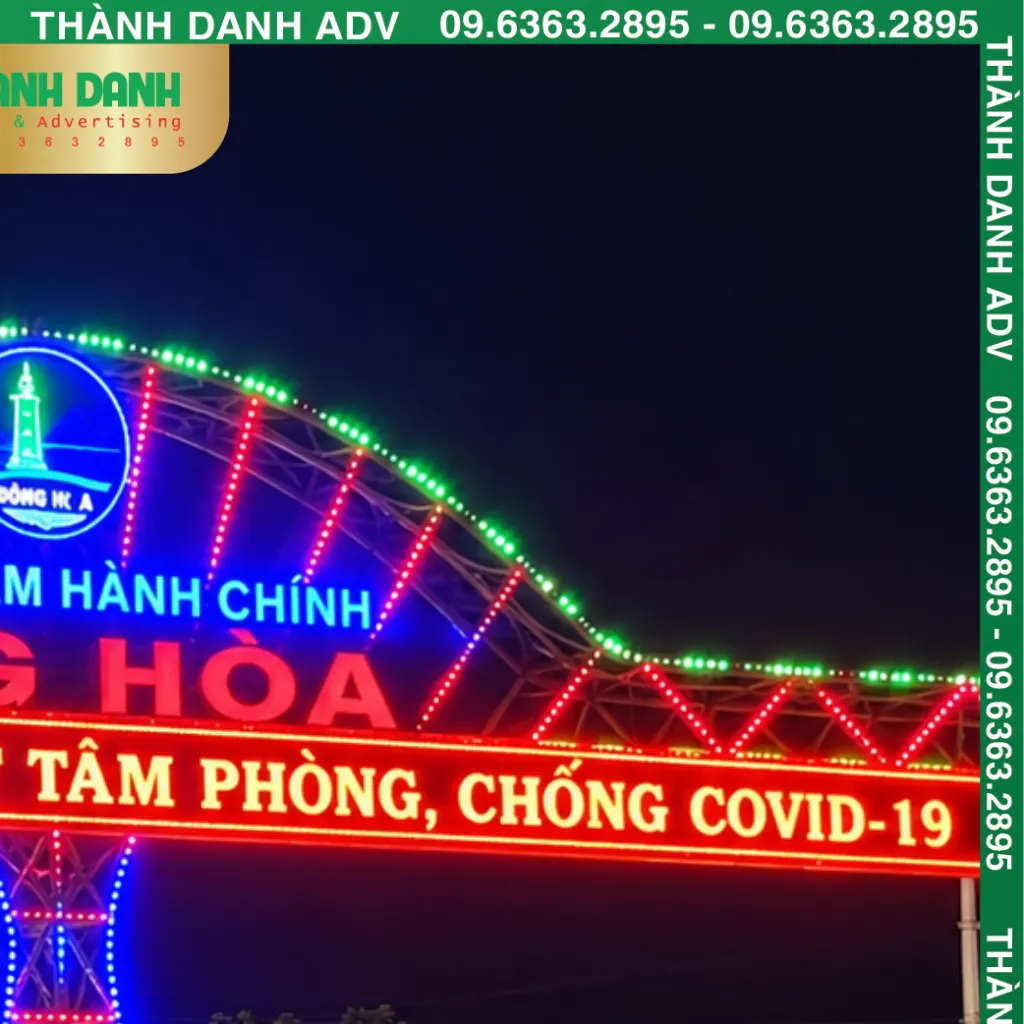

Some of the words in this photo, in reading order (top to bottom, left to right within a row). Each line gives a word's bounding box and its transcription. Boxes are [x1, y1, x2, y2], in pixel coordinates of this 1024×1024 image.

[61, 560, 202, 618] HÀNH
[218, 574, 373, 629] CHÍNH
[100, 628, 398, 728] HÒA
[27, 737, 175, 807] TÂM
[200, 748, 438, 831] PHÒNG,
[458, 758, 669, 833] CHỐNG
[690, 786, 953, 848] COVID-19
